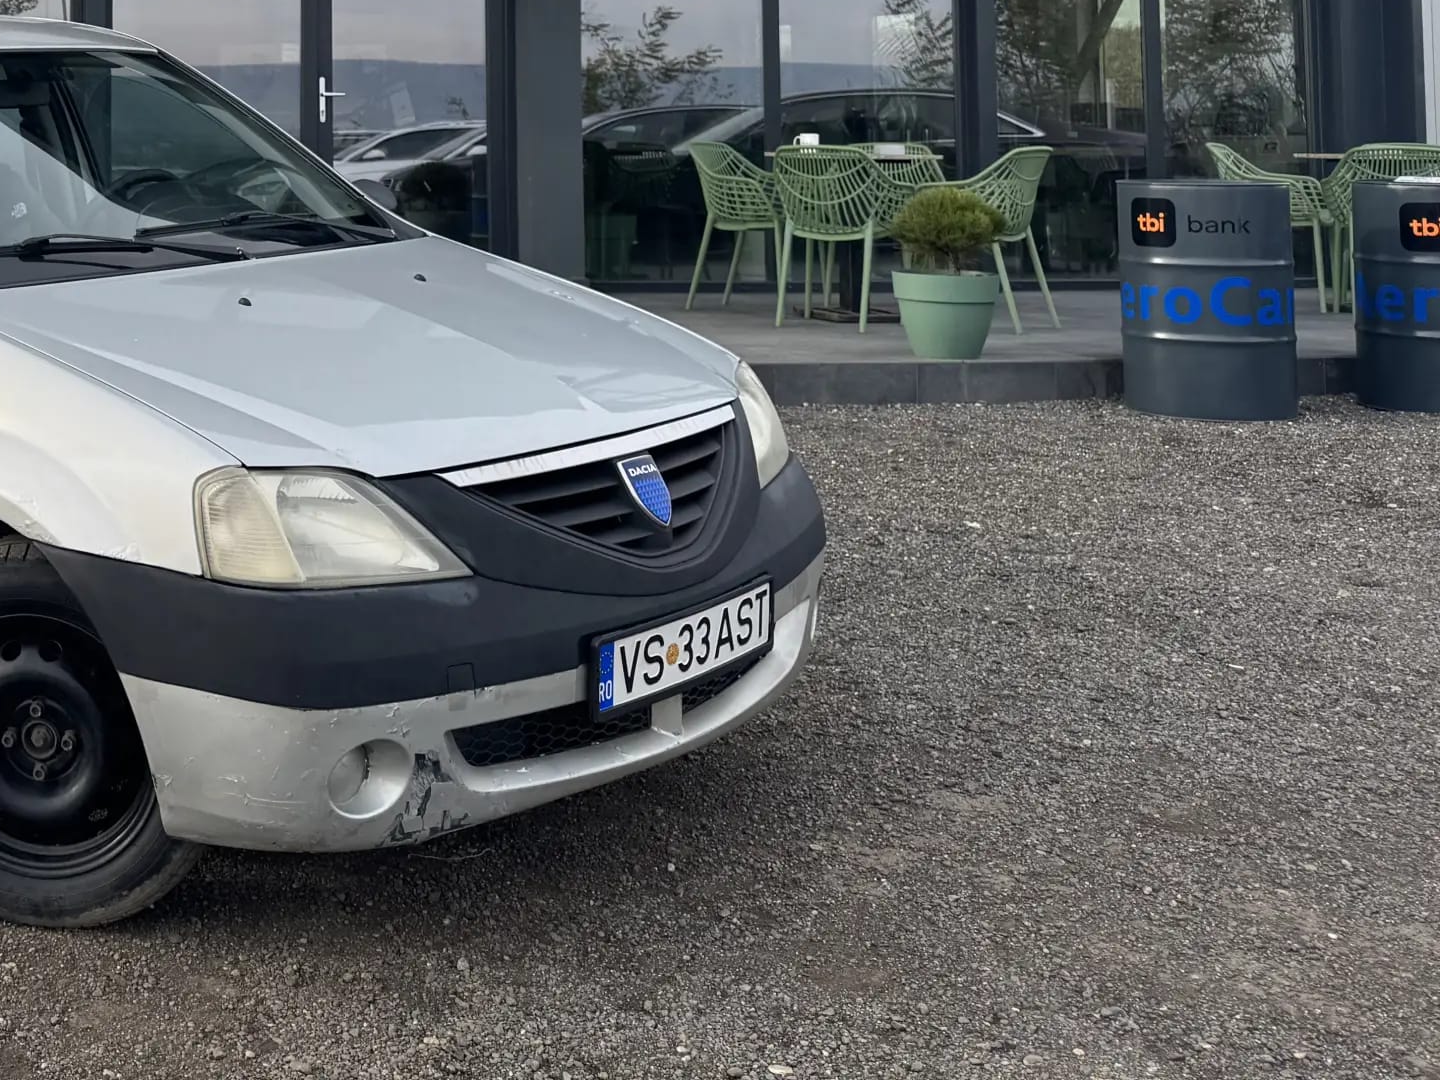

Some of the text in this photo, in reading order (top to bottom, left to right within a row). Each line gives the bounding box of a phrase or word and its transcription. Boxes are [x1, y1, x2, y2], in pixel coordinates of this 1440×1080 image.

[1137, 212, 1251, 234] tbi bank
[628, 463, 657, 477] DACIA
[599, 679, 613, 703] RO
